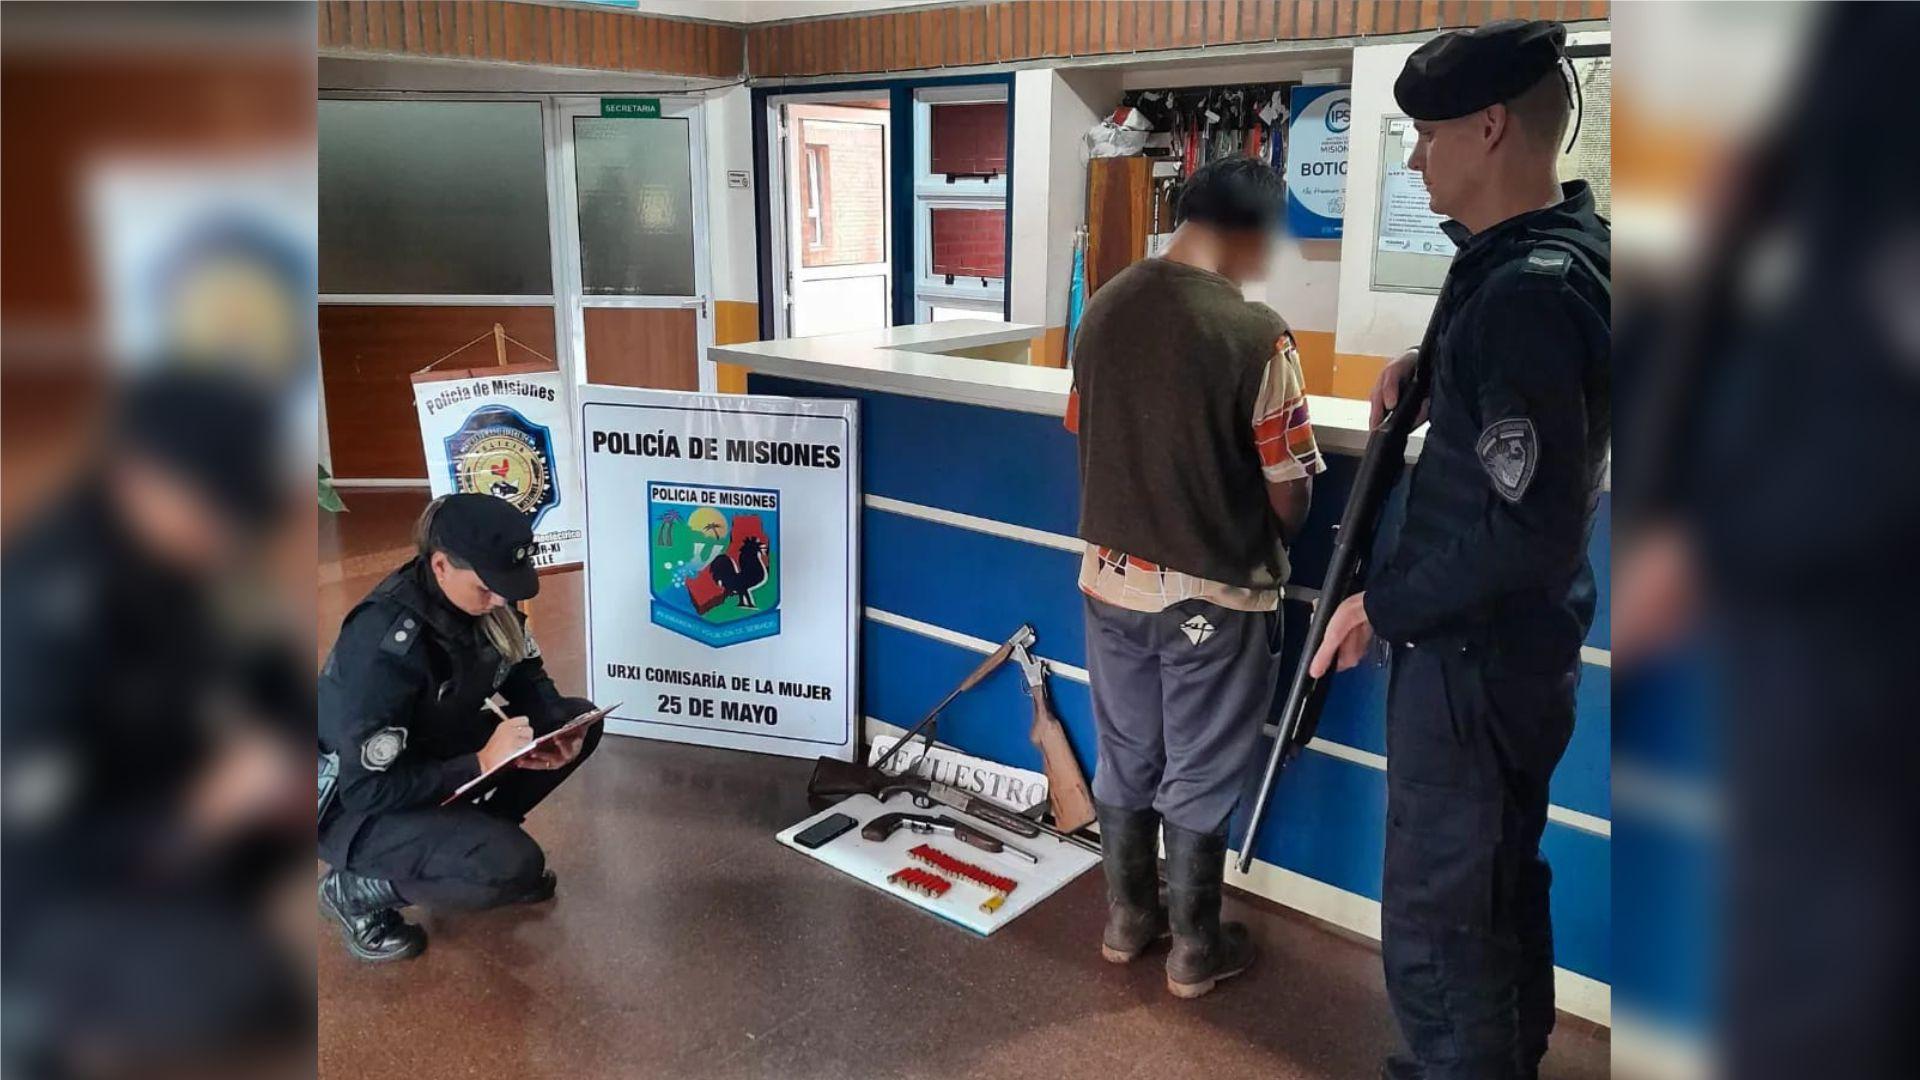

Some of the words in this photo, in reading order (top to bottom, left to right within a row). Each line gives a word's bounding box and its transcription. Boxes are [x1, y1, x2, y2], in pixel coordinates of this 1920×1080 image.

[605, 104, 656, 112] SECRETARIA
[1331, 110, 1351, 123] IPS
[473, 382, 490, 396] de
[492, 380, 555, 401] Misiones
[592, 429, 681, 459] POLICÍA
[688, 437, 718, 460] DE
[725, 440, 841, 469] MISIONES
[652, 487, 698, 503] POLICIA
[701, 491, 716, 504] DE
[719, 492, 776, 508] MISIONES
[607, 664, 640, 680] URXI
[645, 667, 726, 690] COMISARÍA
[731, 677, 750, 692] DE
[755, 679, 774, 694] LA
[778, 682, 832, 701] MUJER
[657, 694, 682, 714] 25
[688, 697, 714, 718] DE
[720, 700, 778, 726] MAYO
